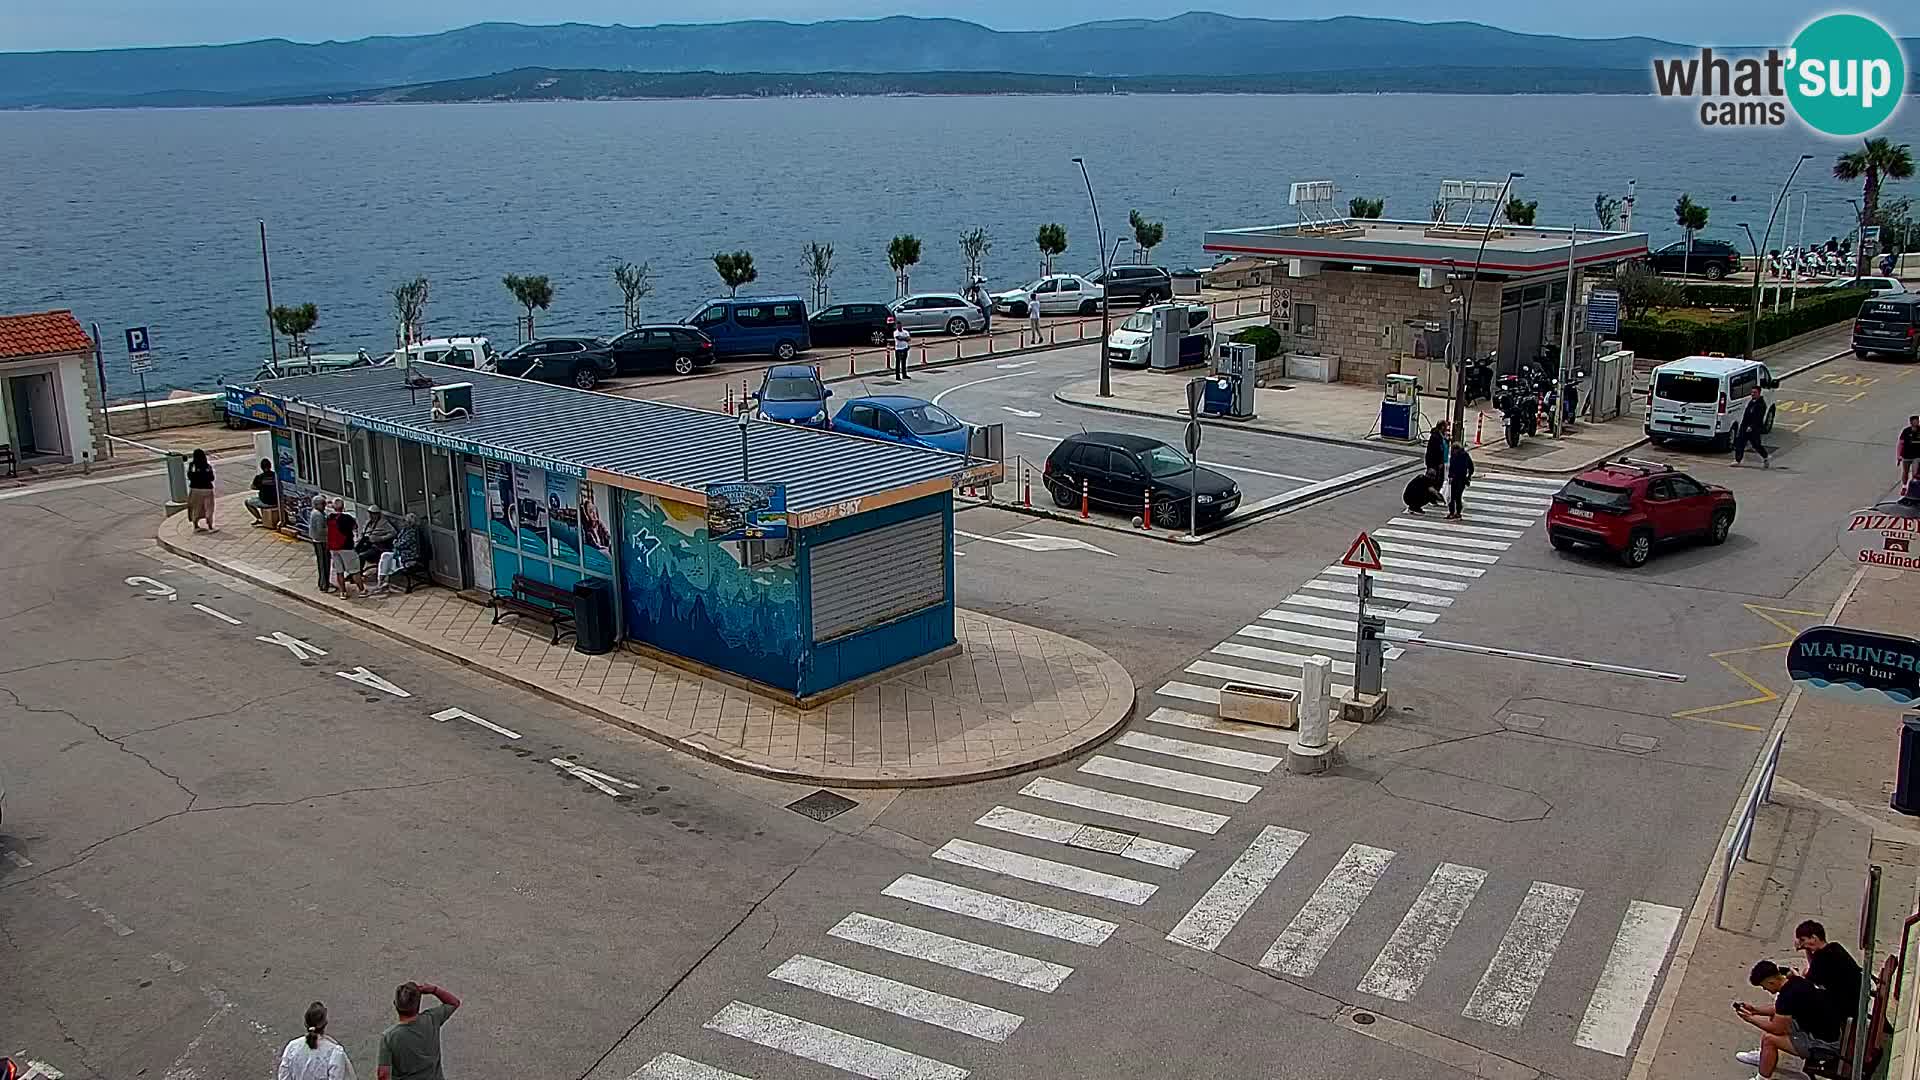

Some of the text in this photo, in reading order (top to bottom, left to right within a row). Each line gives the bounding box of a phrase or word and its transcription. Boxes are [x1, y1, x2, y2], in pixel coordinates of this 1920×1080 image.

[131, 330, 143, 349] P
[1813, 373, 1880, 387] TAXI
[397, 426, 436, 444] AUTOBUSNA
[437, 438, 468, 452] POSTAJA
[478, 446, 493, 457] BUS
[494, 449, 526, 465] STATION
[528, 456, 554, 470] TICKET
[555, 463, 582, 477] OFFICE
[1881, 530, 1916, 540] GRILL
[1828, 662, 1896, 680] caffe bar
